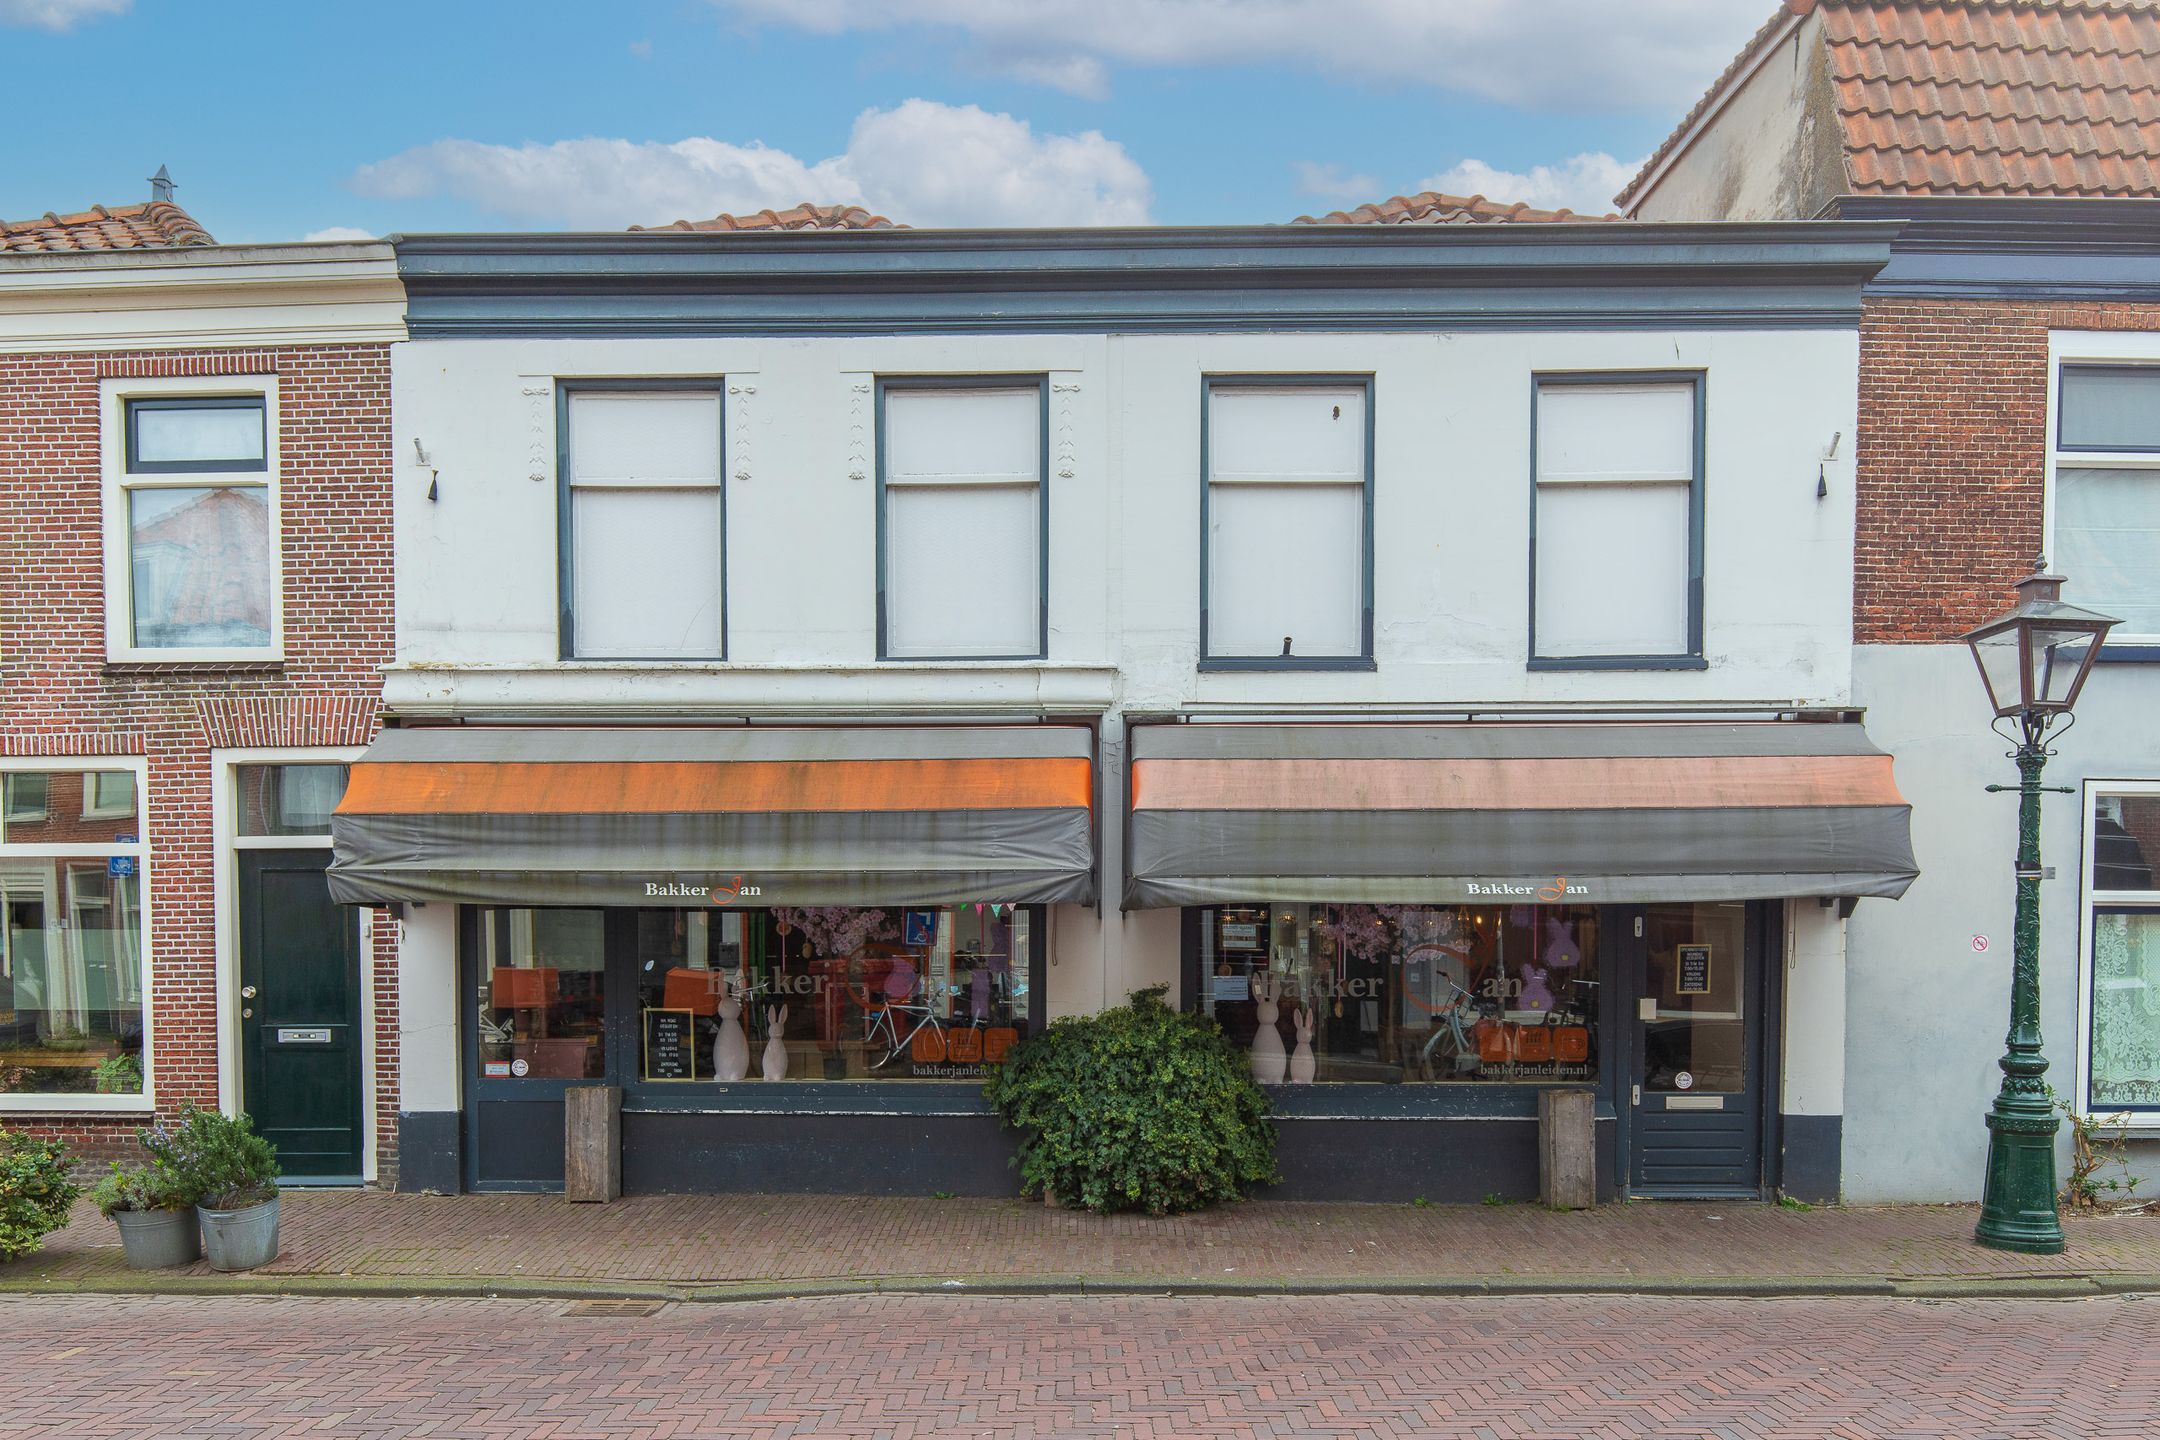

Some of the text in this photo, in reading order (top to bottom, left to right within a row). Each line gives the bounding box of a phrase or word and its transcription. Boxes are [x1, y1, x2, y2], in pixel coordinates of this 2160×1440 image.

[645, 875, 761, 905] Bakker Jan
[1467, 877, 1589, 902] Bakker Jan
[704, 965, 829, 995] Bkker
[1480, 1064, 1588, 1077] bakkerjanleiden.nl
